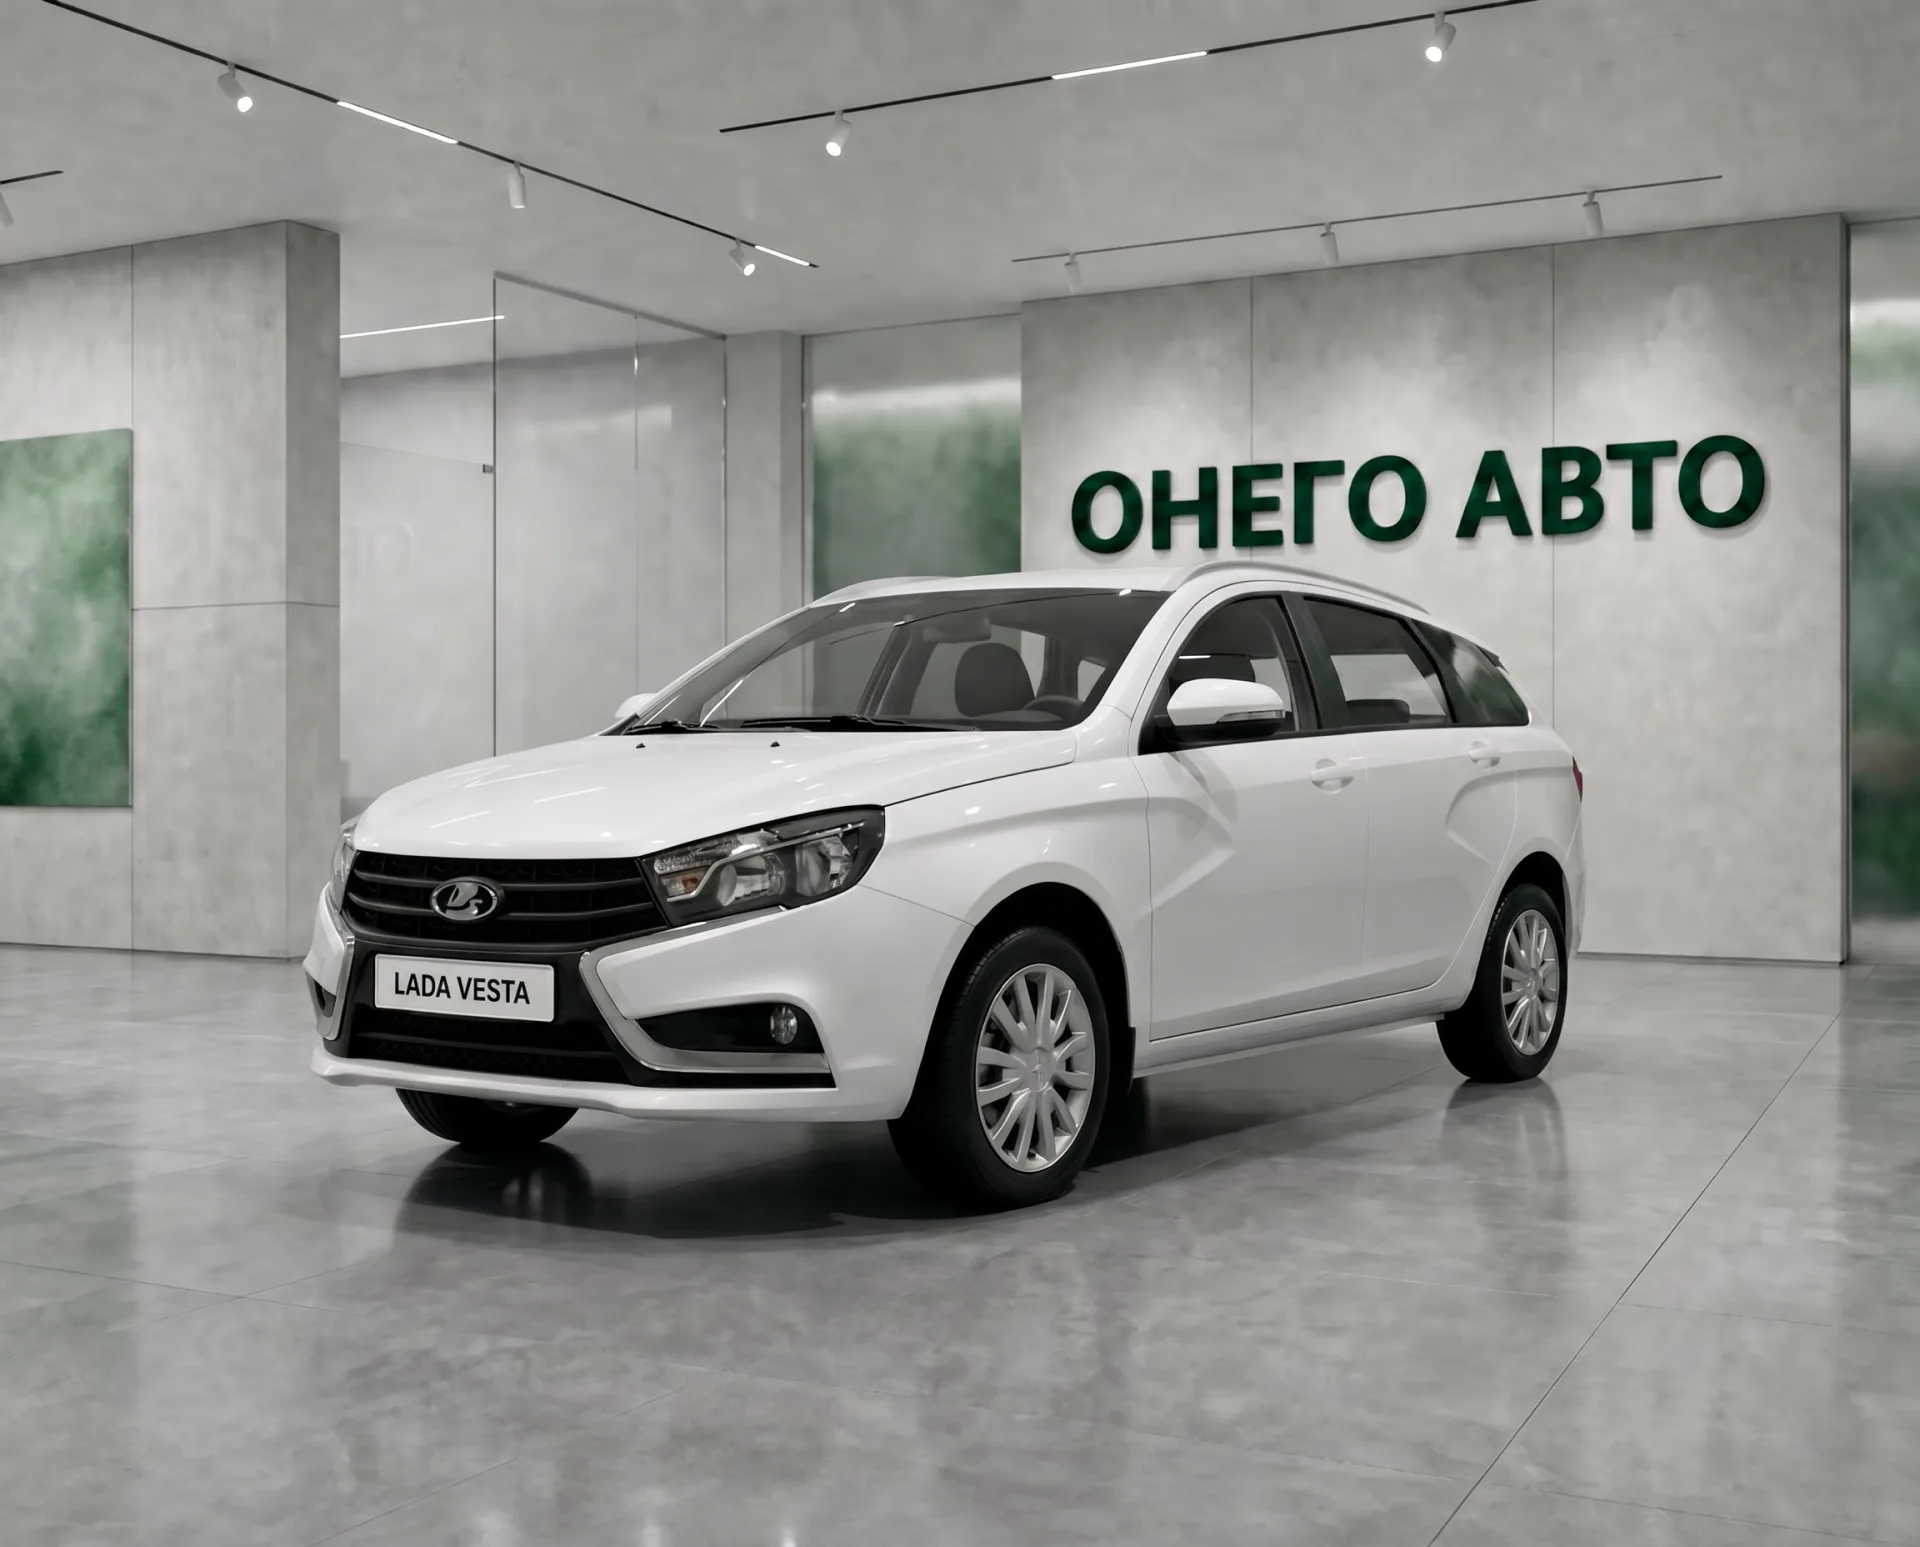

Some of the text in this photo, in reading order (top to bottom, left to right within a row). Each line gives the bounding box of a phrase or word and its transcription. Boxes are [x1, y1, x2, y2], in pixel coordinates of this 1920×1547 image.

[1072, 434, 1767, 555] ОНЕГО АВТО
[394, 972, 531, 1005] LADA VESTA
